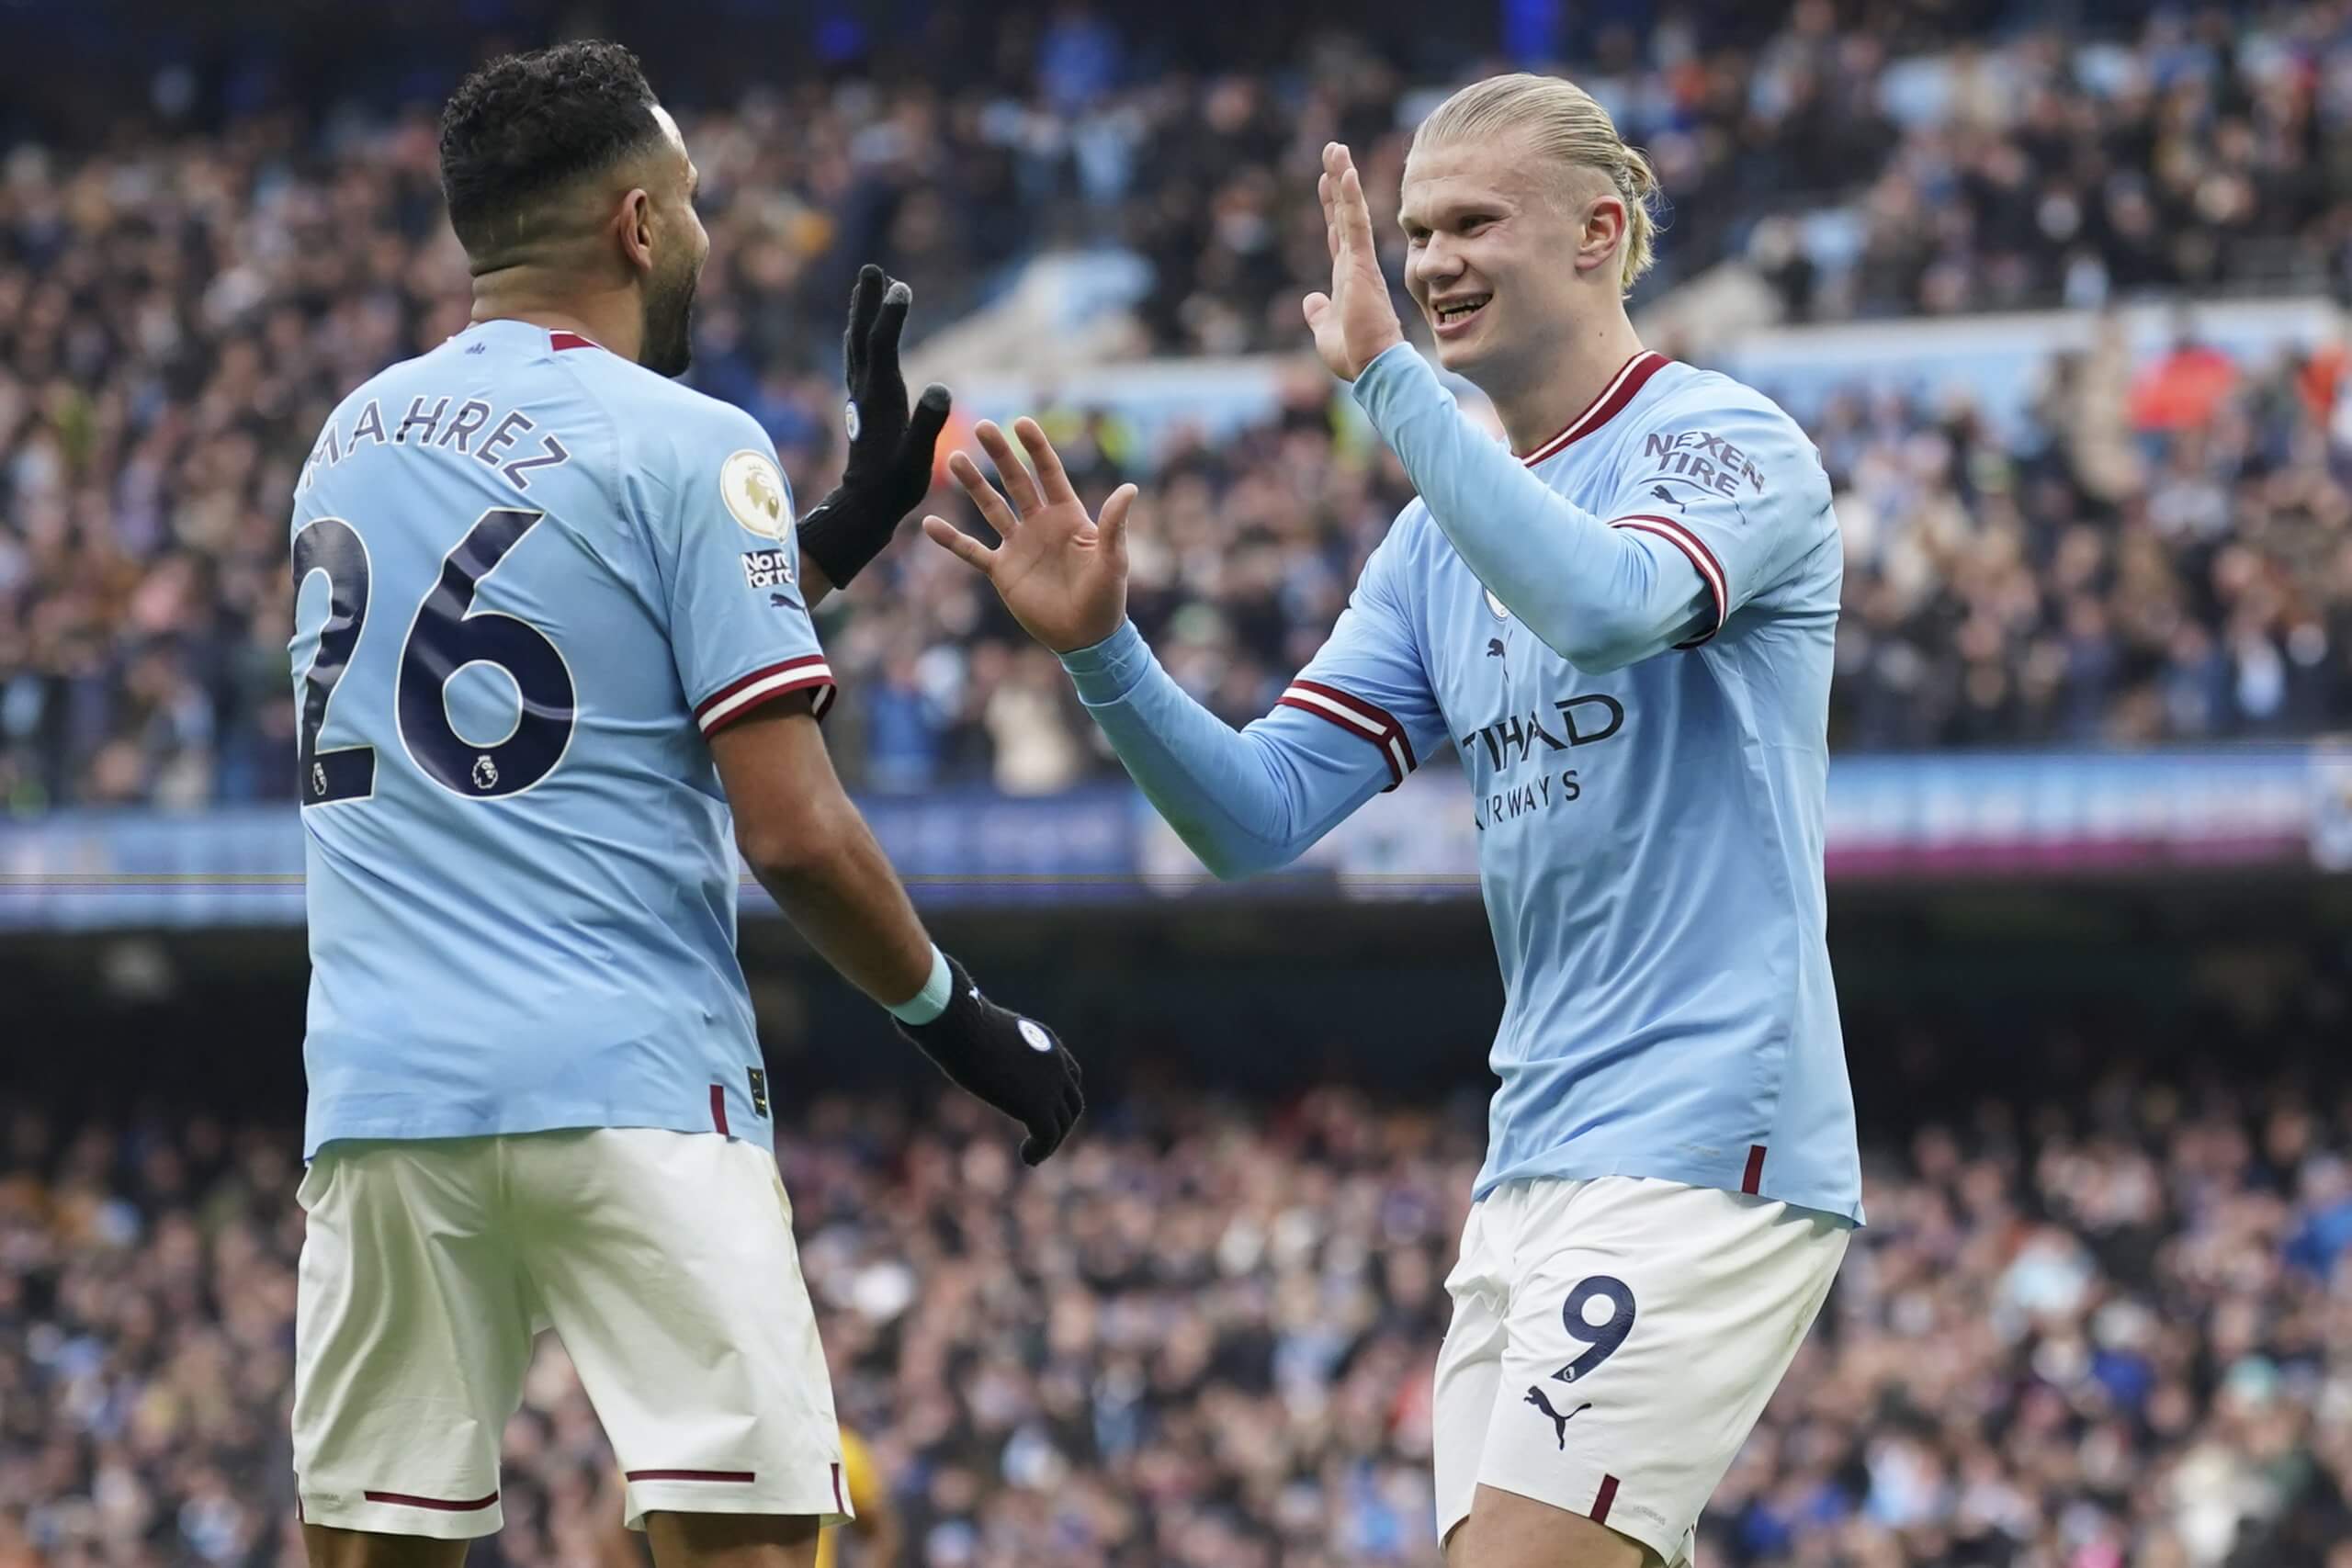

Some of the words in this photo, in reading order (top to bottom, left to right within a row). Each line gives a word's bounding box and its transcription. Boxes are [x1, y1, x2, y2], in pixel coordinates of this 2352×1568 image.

[1645, 431, 1765, 494] NEXEN
[1657, 452, 1740, 498] TIRE
[290, 507, 575, 807] 26
[1462, 694, 1624, 773] TIHAD
[1551, 1275, 1637, 1384] 9
